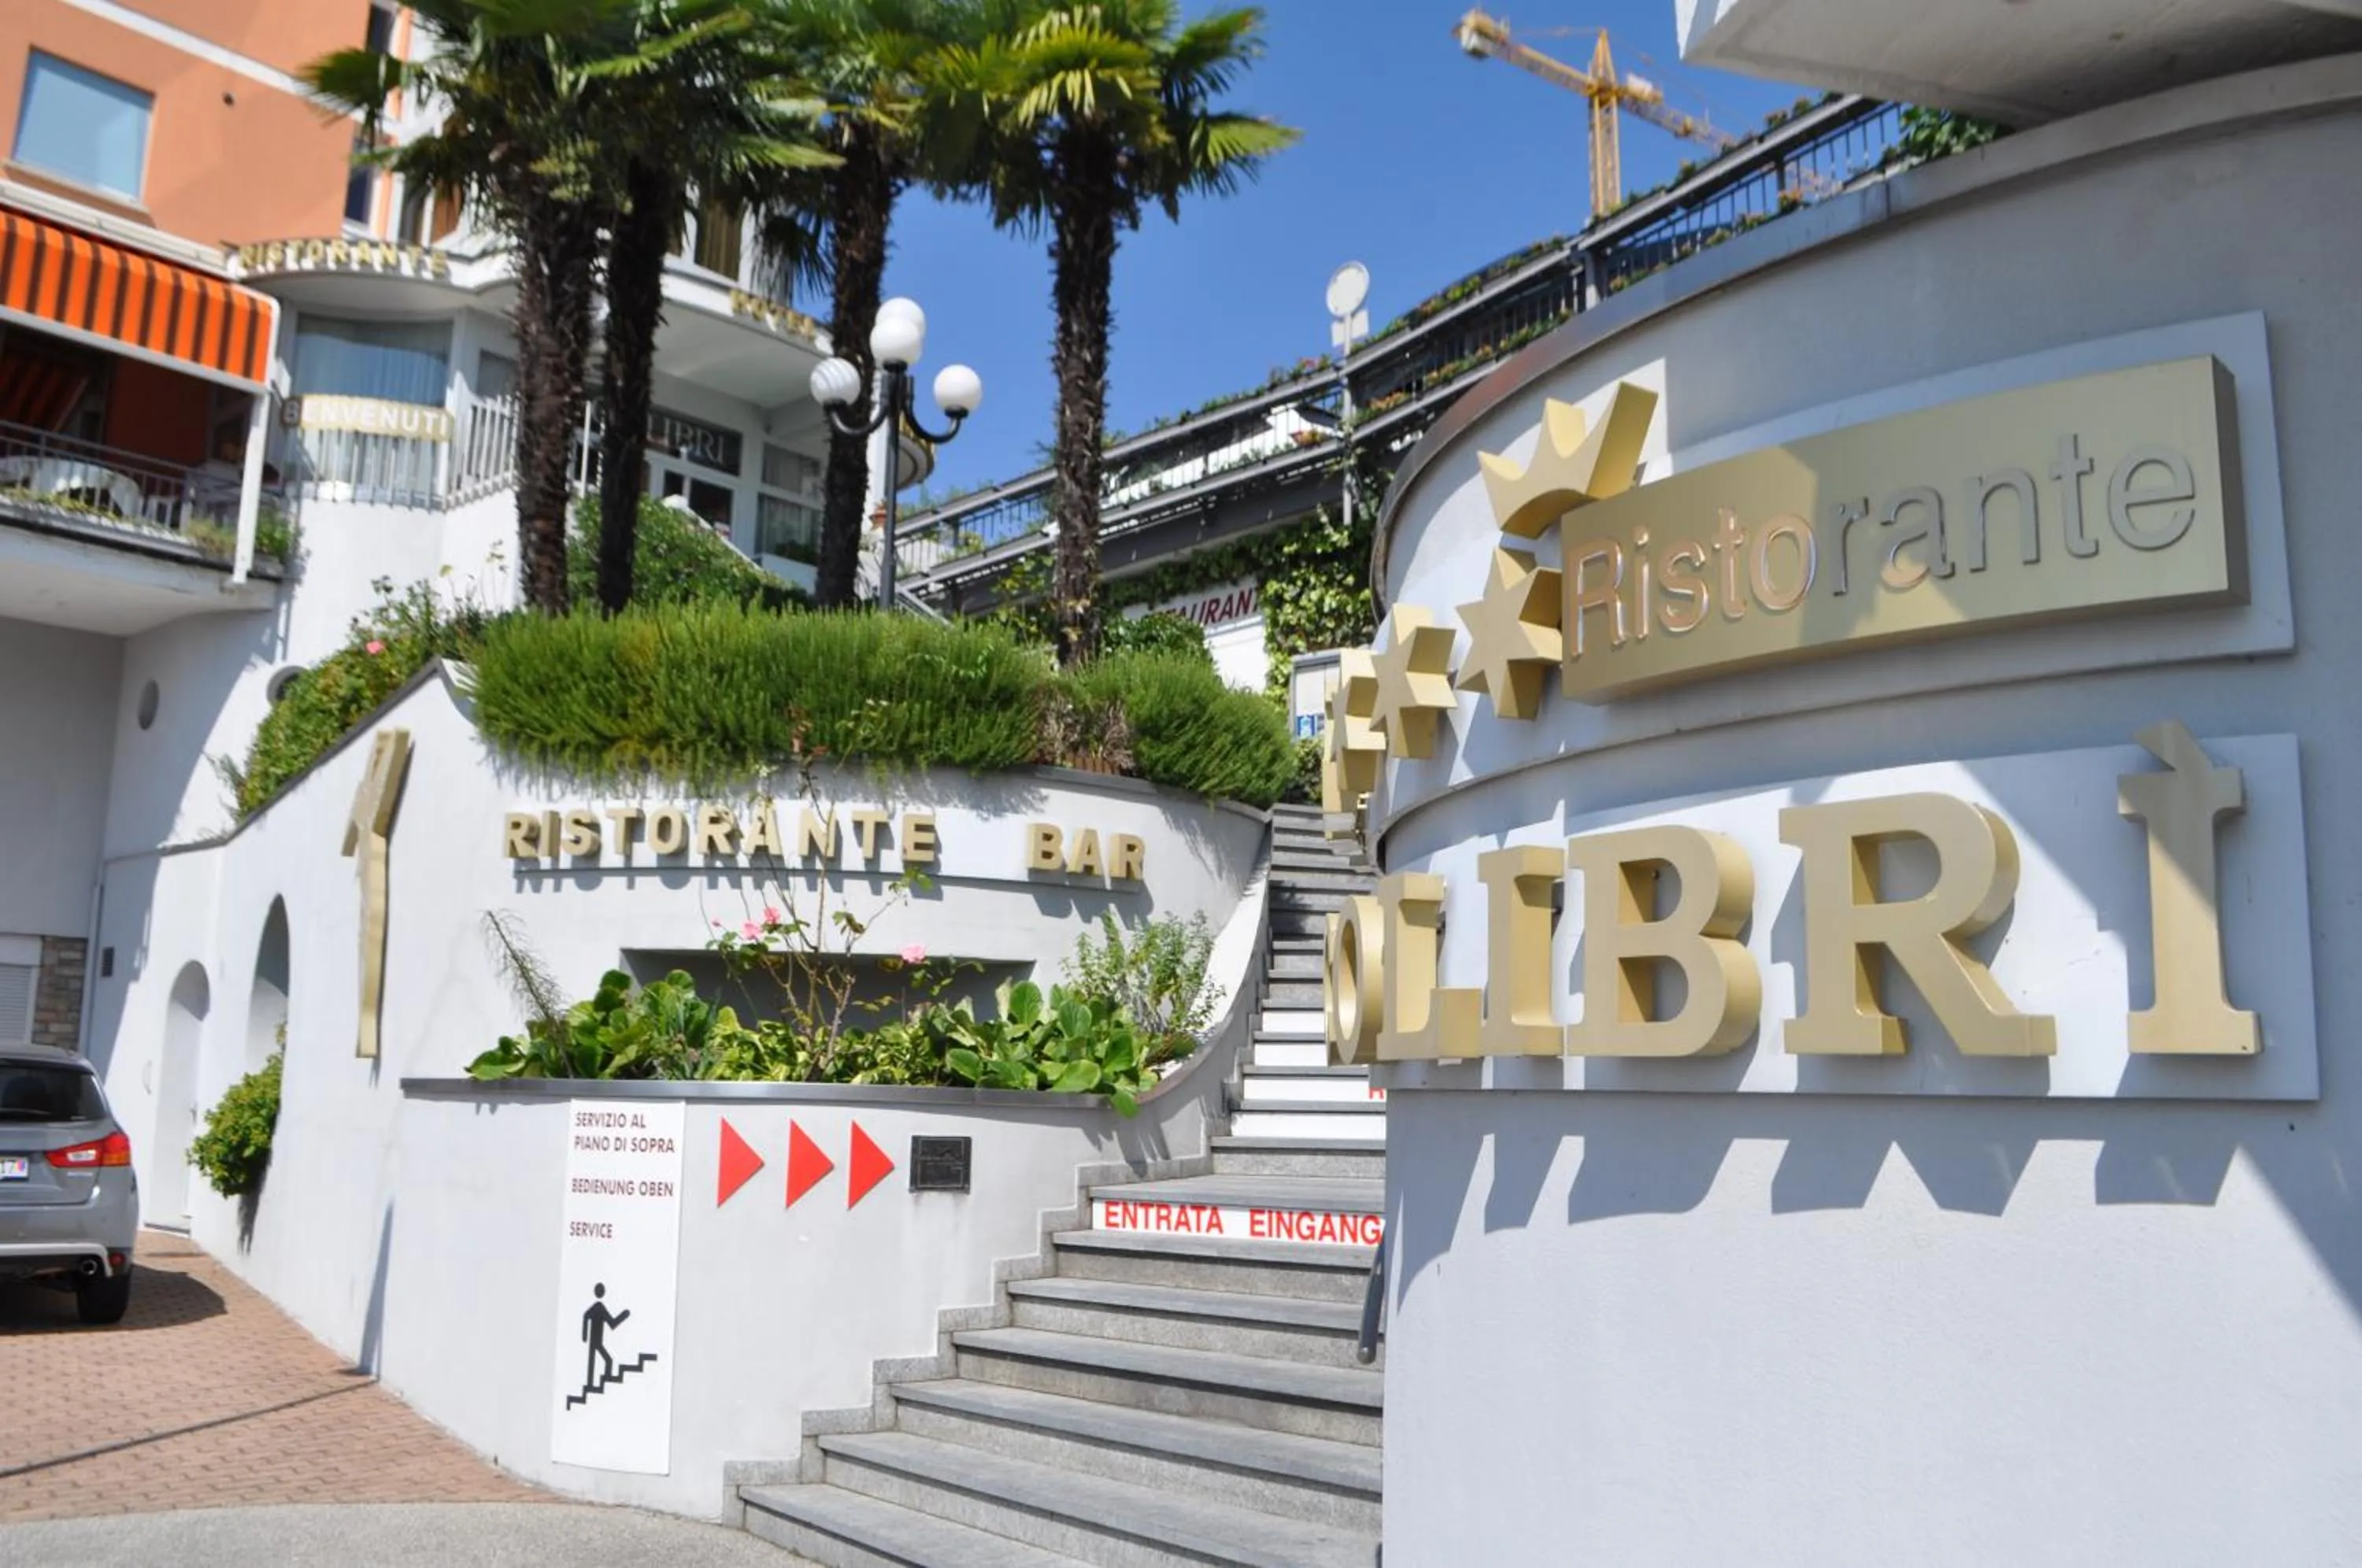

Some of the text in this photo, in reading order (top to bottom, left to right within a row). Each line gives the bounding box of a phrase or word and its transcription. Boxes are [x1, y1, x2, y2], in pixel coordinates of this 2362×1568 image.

[239, 239, 446, 276] RISTORANTE
[283, 398, 449, 435] BENVENUTI
[1568, 432, 2196, 660] Ristorante
[503, 805, 1146, 881] RISTORANTE BAR
[1324, 764, 2261, 1067] OLIBRI
[575, 1111, 646, 1128] SERVIZIO AL
[574, 1136, 675, 1153] PIANO DI SOPRA
[571, 1178, 674, 1196] BEDIENUNG OBEN
[569, 1221, 613, 1238] SERVICE
[1105, 1200, 1383, 1244] ENTRATA EINGANG
